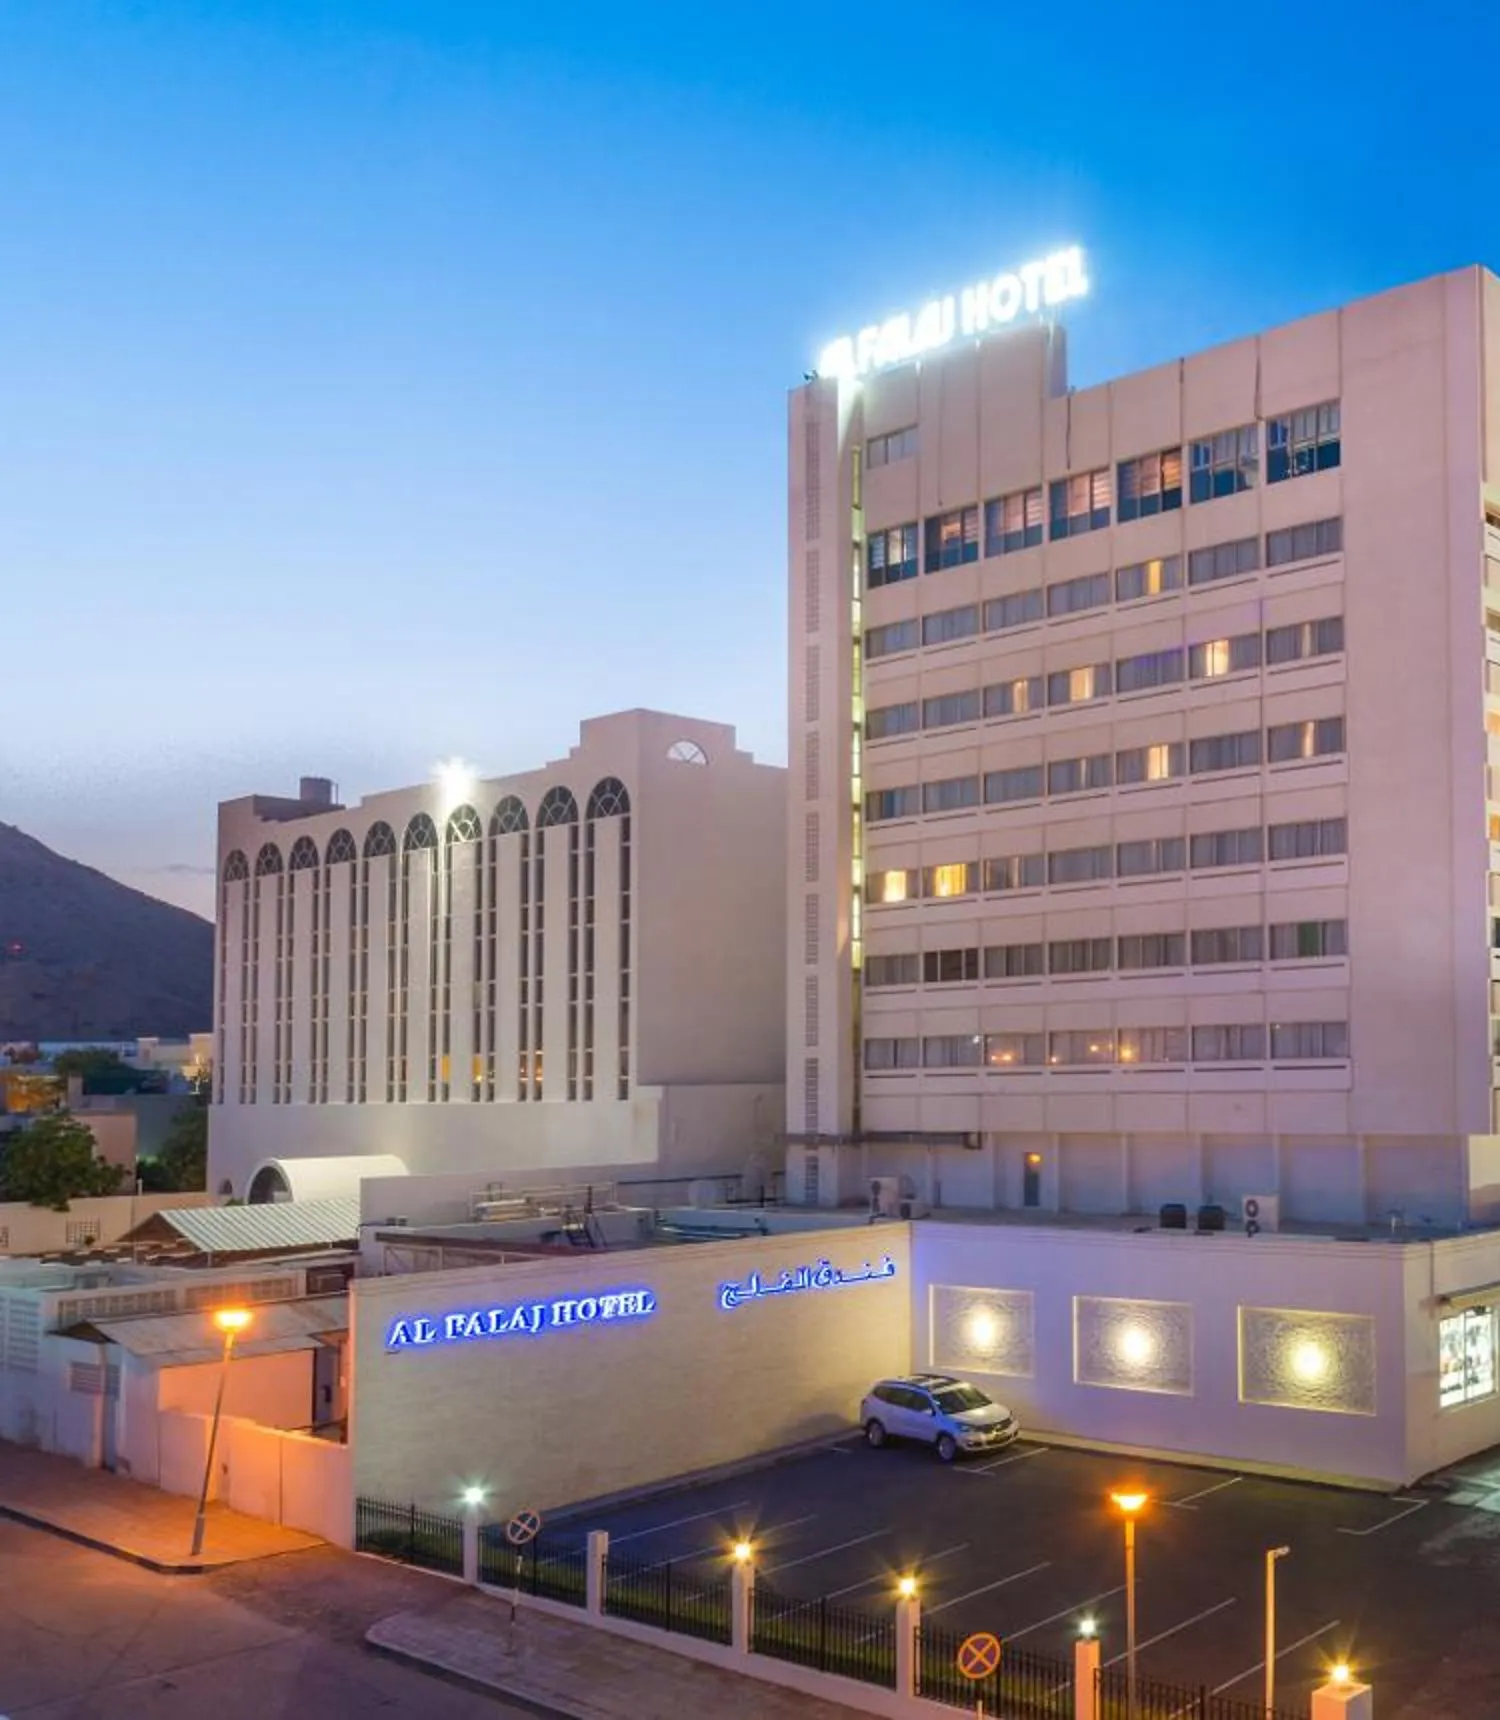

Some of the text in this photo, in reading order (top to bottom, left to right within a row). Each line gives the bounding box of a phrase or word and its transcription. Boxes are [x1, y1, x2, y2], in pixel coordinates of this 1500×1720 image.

[961, 246, 1089, 335] HOTEL
[722, 1255, 896, 1309] فندق الفلج
[388, 1290, 657, 1346] AL FALAJ HOTEL
